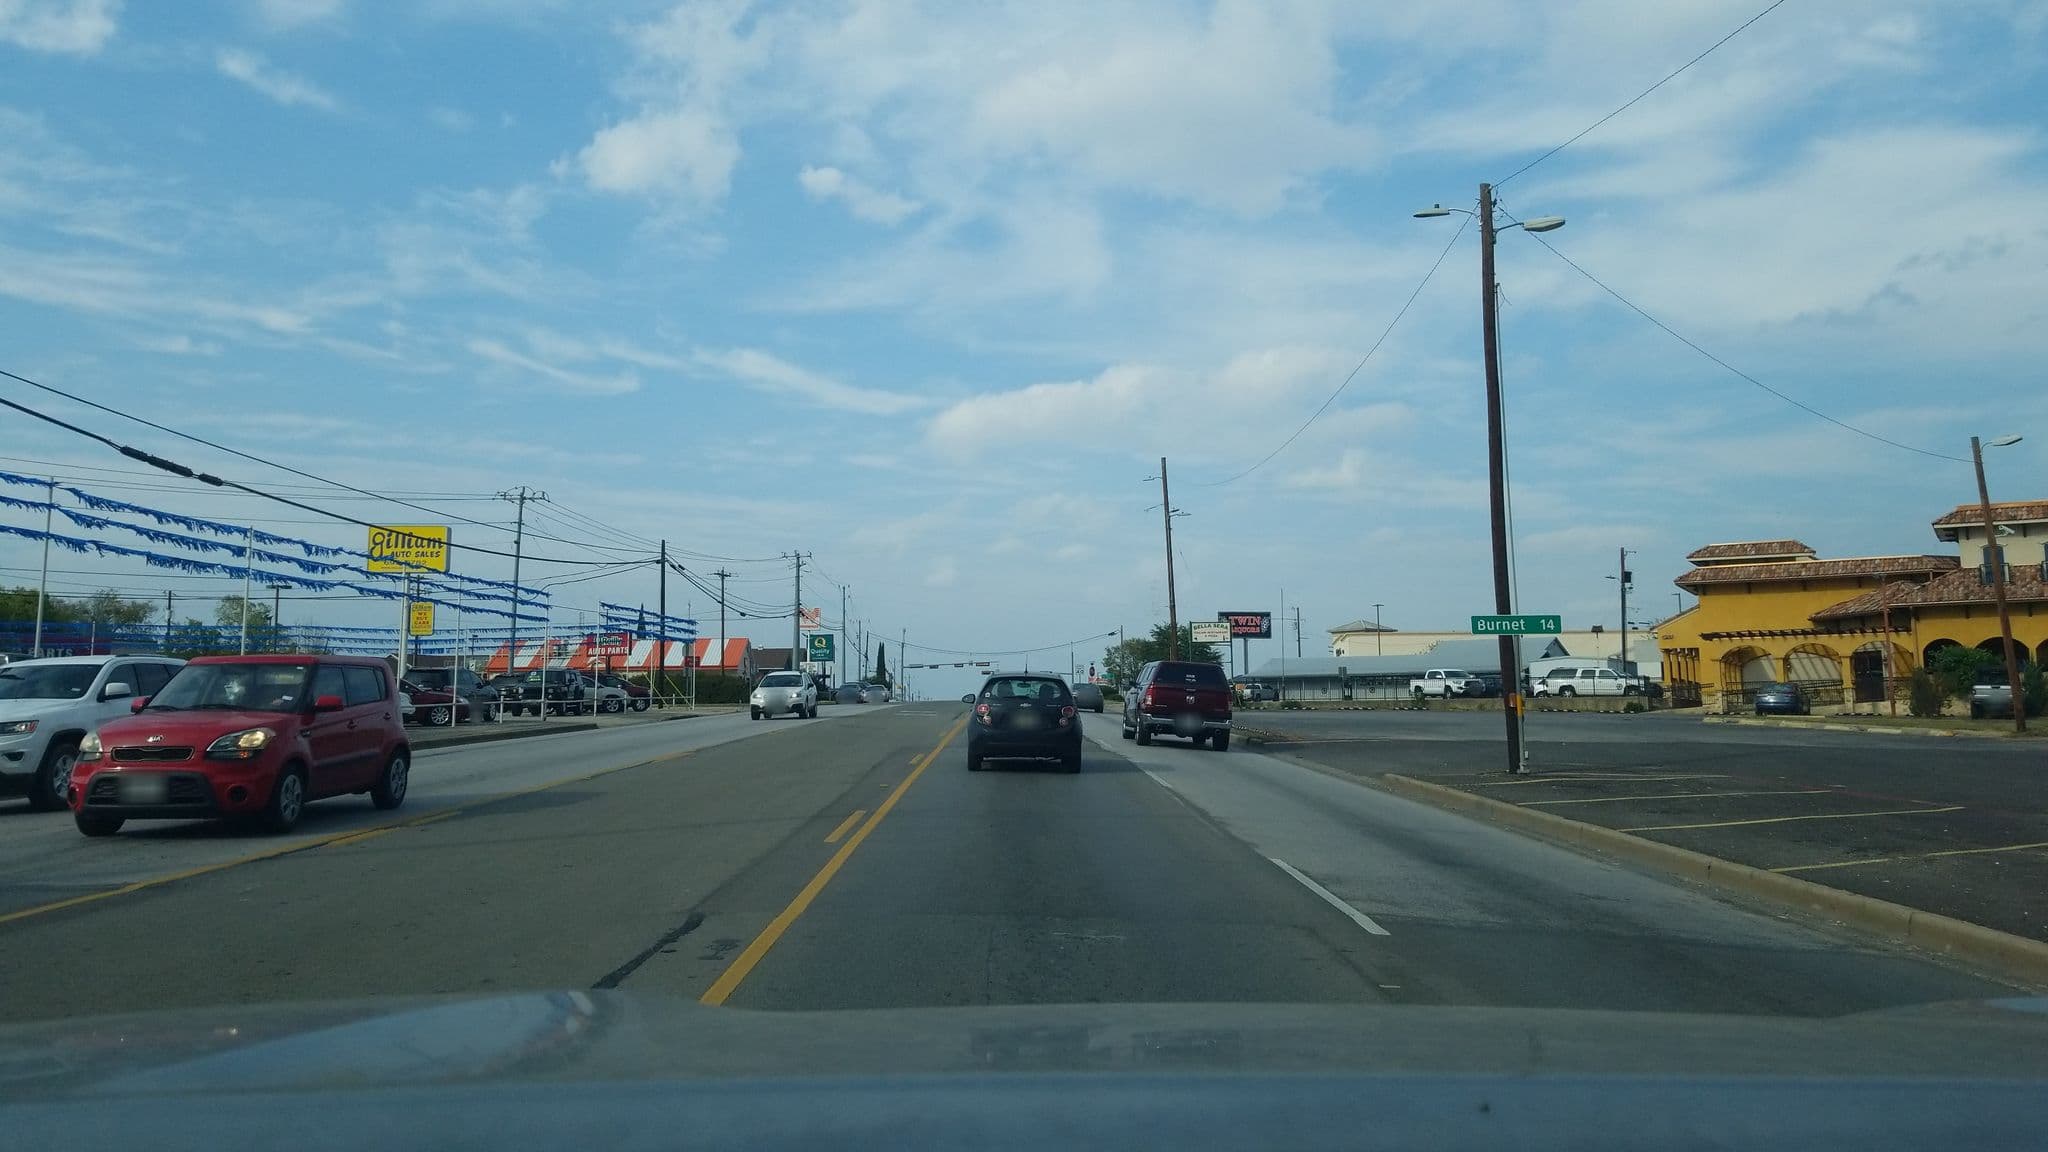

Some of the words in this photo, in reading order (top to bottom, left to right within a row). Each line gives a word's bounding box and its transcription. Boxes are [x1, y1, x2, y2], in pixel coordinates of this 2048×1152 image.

[391, 550, 411, 558] AUTO
[414, 550, 441, 558] SALES
[1228, 616, 1261, 626] TWIN
[1477, 619, 1526, 631] Burnet
[1540, 619, 1555, 631] 14
[588, 647, 605, 655] AUTO
[607, 646, 628, 655] PARTS
